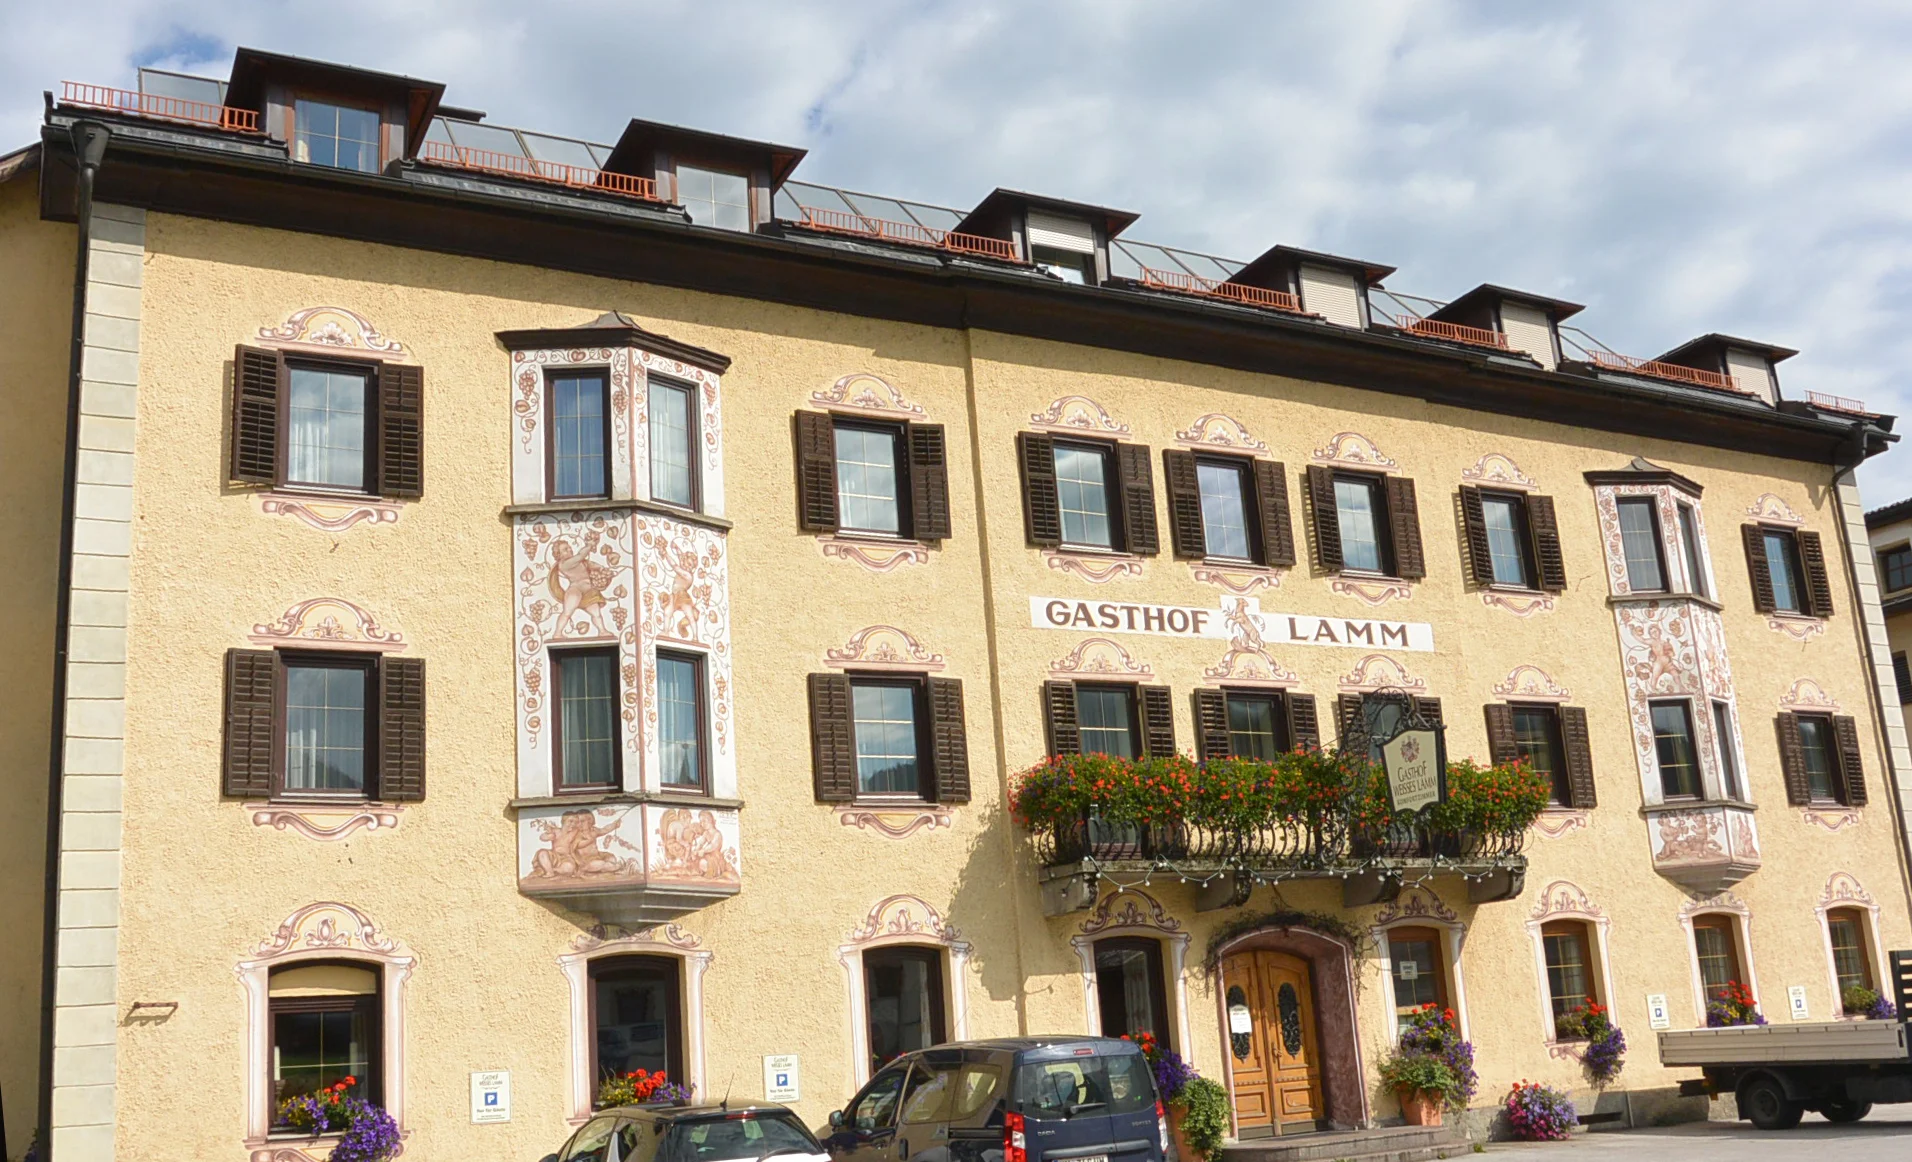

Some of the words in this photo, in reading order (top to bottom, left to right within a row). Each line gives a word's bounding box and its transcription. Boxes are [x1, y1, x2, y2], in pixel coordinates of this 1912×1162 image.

[1045, 600, 1210, 634] GASTHOF
[1288, 617, 1409, 647] LAMM
[1397, 761, 1427, 782] GASTHOF
[1393, 780, 1416, 796] WEISSES
[1416, 776, 1437, 791] LAMM
